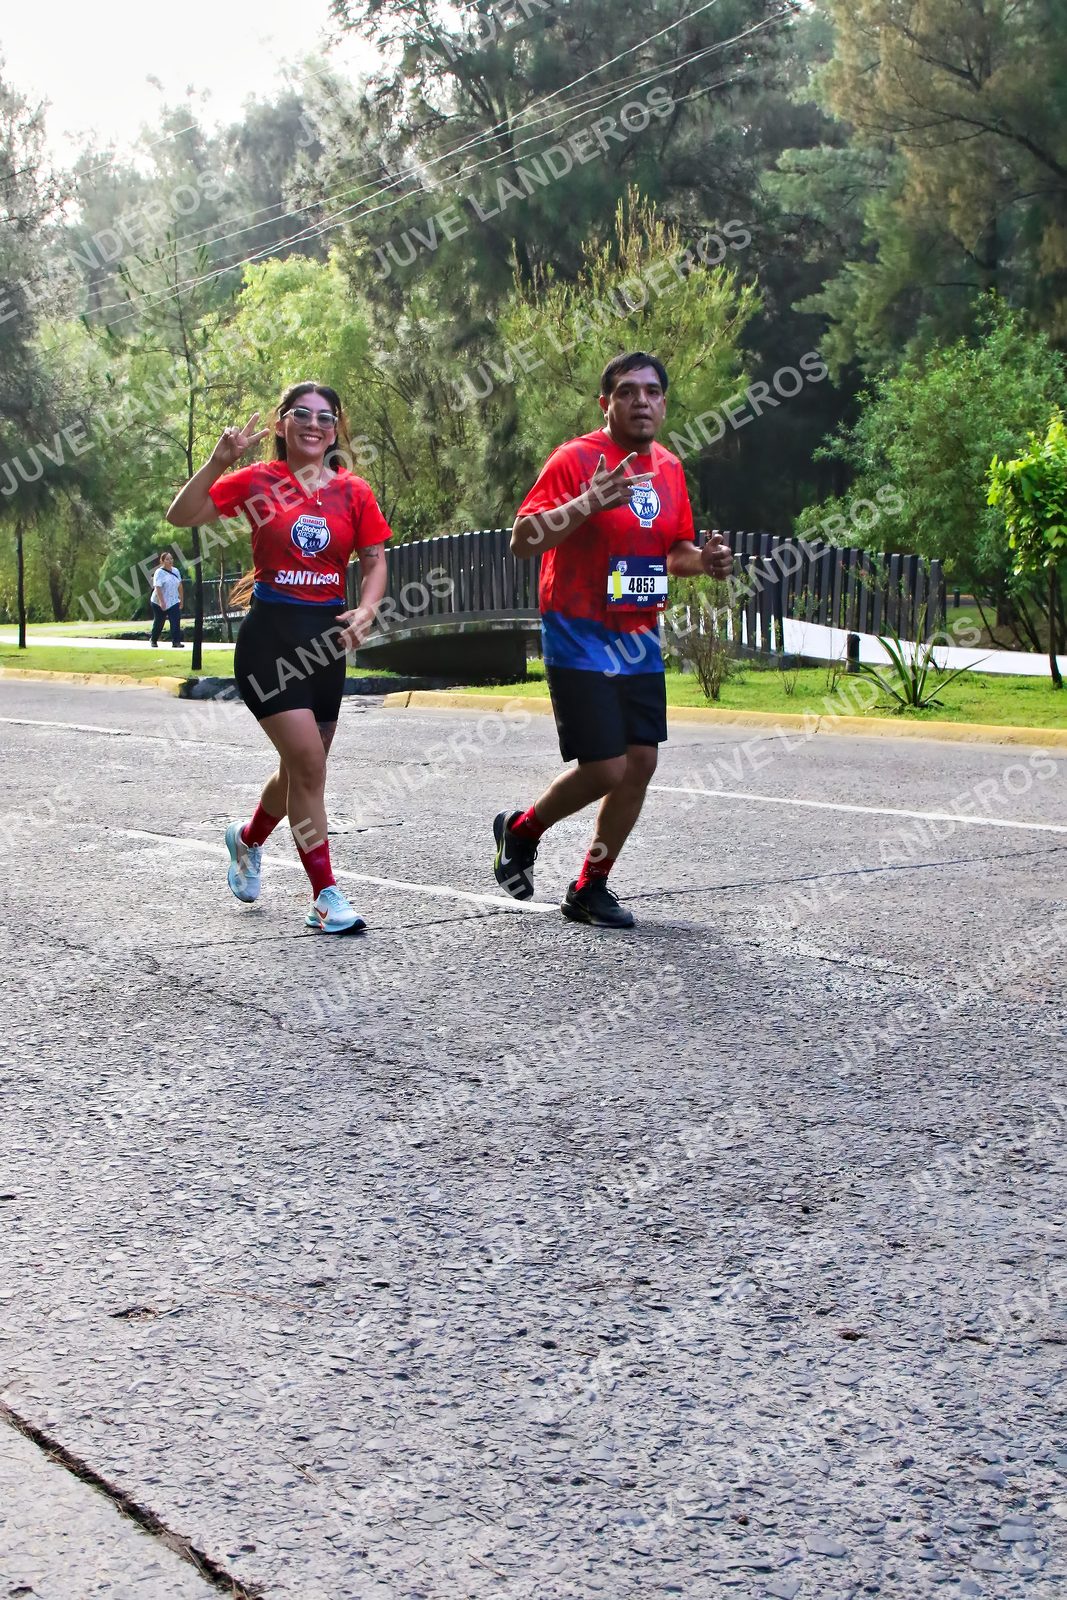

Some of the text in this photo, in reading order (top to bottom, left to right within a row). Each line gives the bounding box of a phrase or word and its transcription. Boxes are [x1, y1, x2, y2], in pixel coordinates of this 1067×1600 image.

[302, 518, 323, 526] BIMBO
[297, 529, 313, 538] Race
[302, 525, 322, 534] Global
[628, 578, 655, 593] 4853
